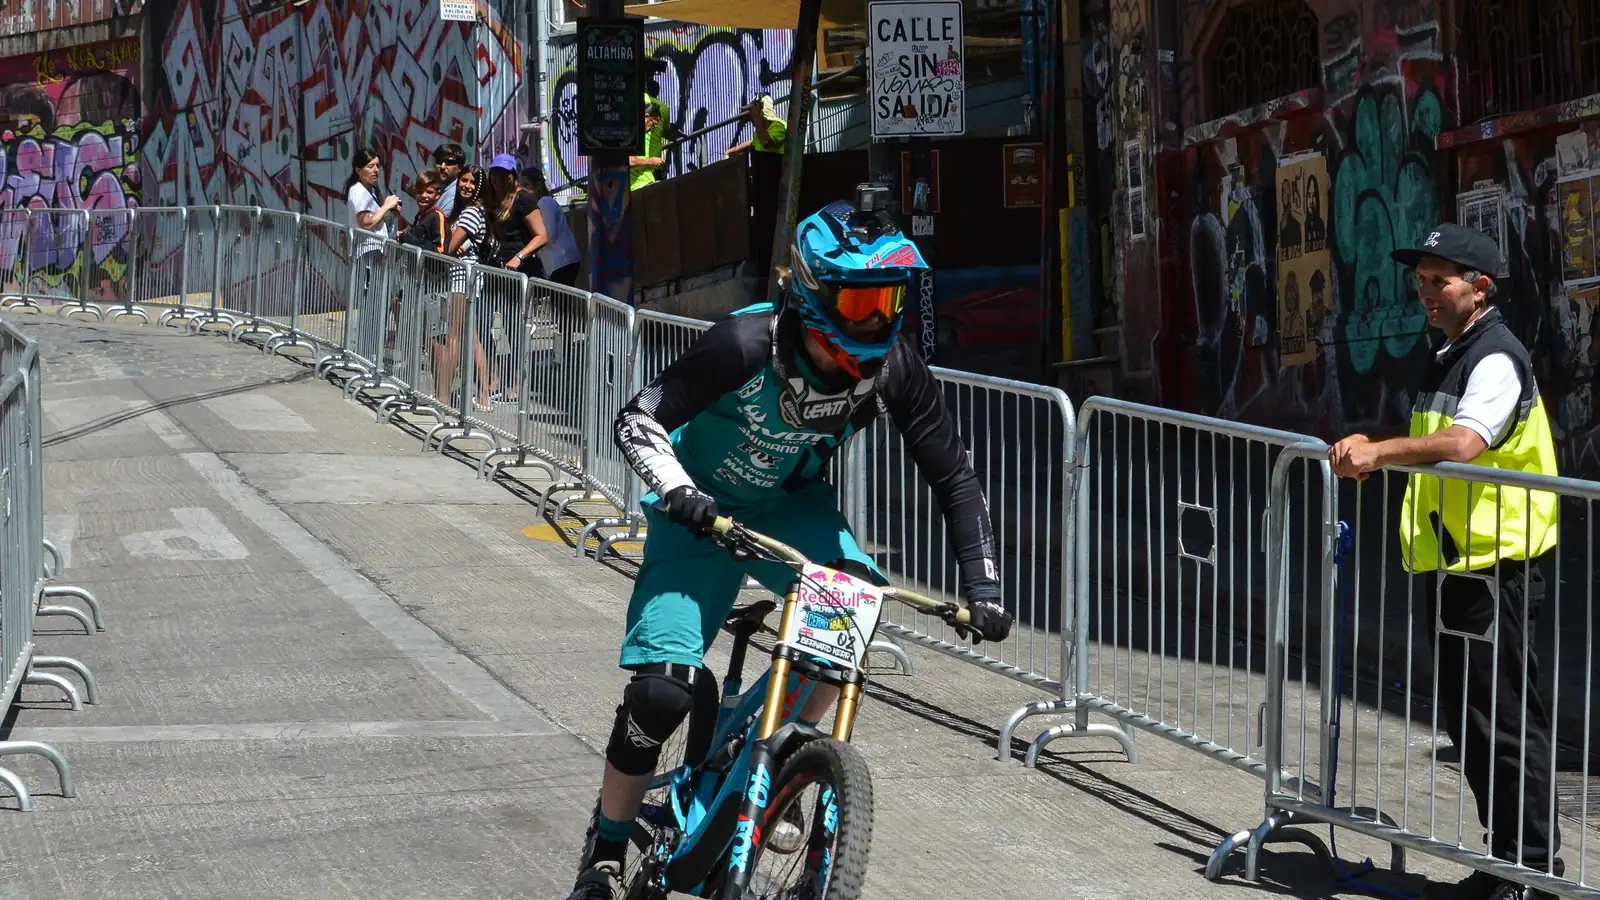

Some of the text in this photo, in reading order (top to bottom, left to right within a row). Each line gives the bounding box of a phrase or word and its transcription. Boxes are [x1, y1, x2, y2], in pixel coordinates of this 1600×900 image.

[877, 17, 955, 42] CALLE
[587, 45, 633, 60] ALTAMIRA
[898, 53, 938, 79] SIN
[803, 400, 848, 420] LEATT
[738, 426, 799, 454] SHIMANO
[723, 458, 775, 488] MAXXIS
[800, 636, 851, 660] BERNARD KERR
[837, 632, 856, 650] 02
[748, 763, 771, 808] 40
[728, 818, 756, 873] FOX
